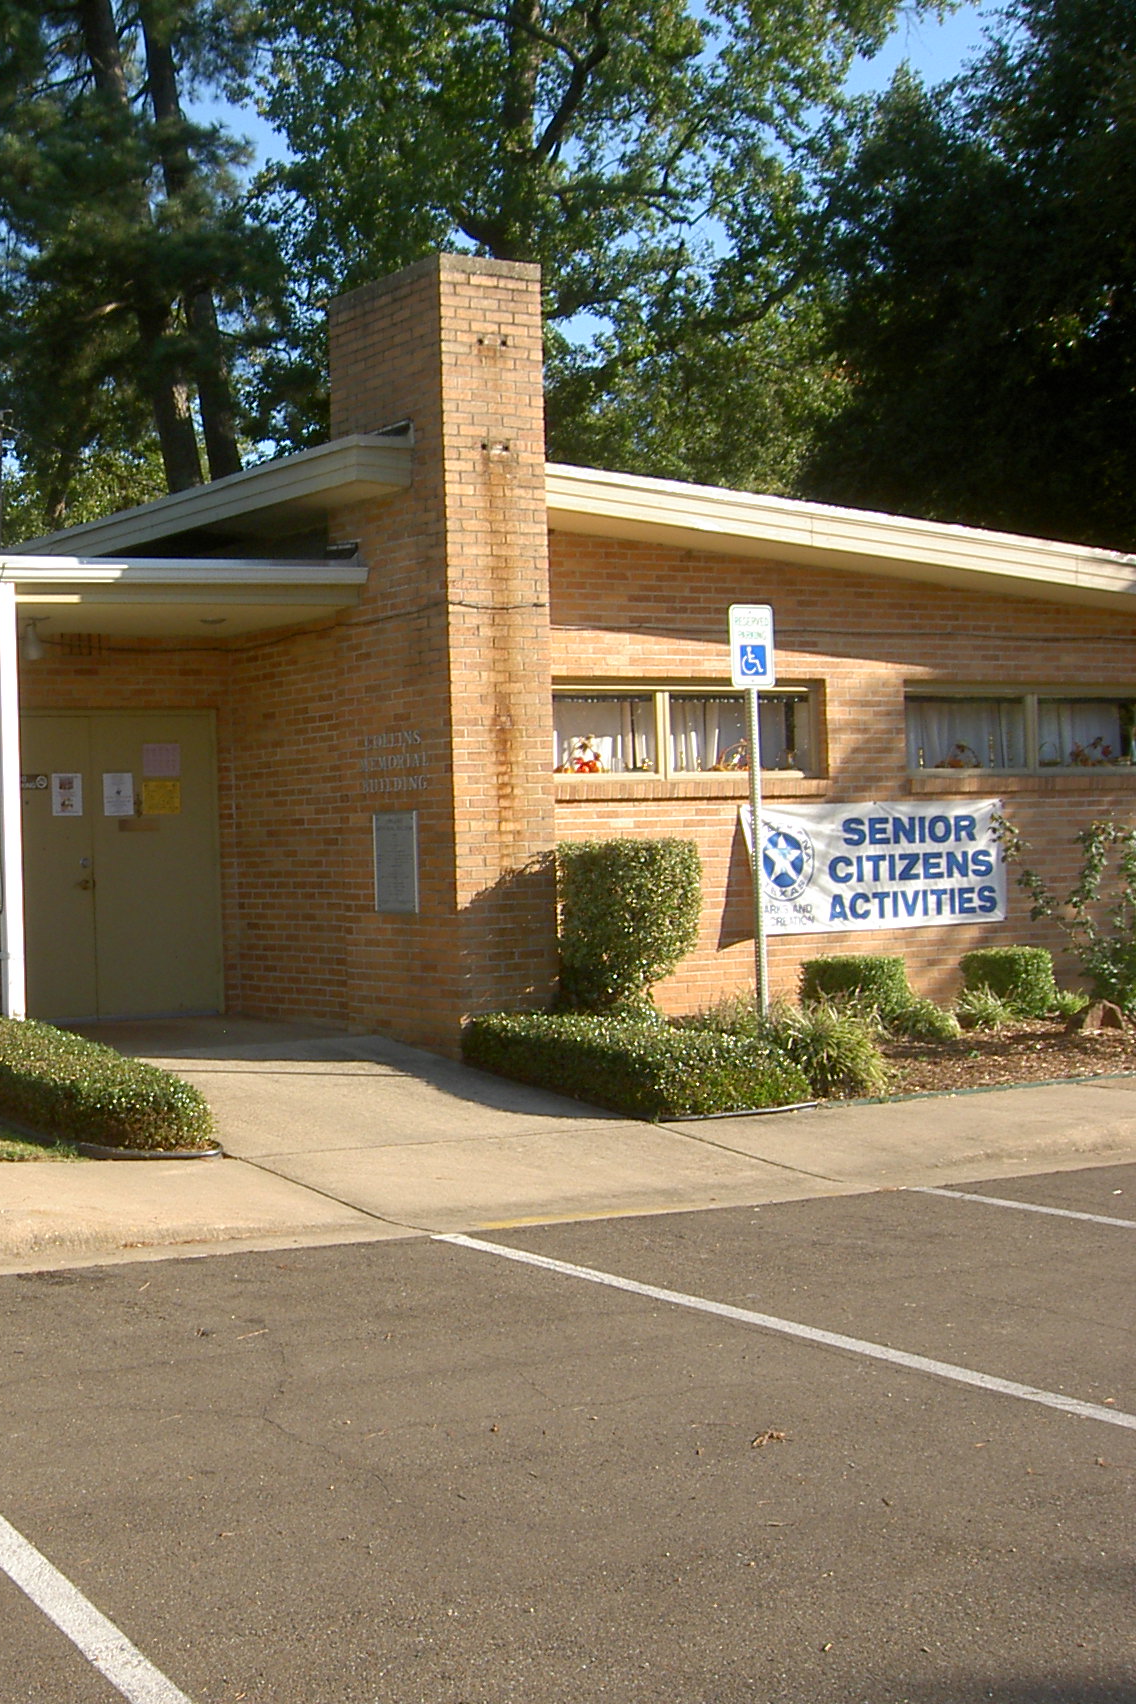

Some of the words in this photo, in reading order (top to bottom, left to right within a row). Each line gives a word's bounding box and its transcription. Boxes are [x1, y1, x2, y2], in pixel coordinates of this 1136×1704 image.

[735, 616, 769, 626] RESERVED
[738, 630, 767, 640] PARKING
[364, 730, 422, 748] COLLINS
[360, 752, 430, 771] MEMORIAL
[363, 775, 429, 793] BUILDING
[842, 815, 977, 847] SENIOR
[828, 849, 994, 884] CITIZENS
[792, 903, 813, 914] AND
[828, 885, 998, 922] ACTIVITIES
